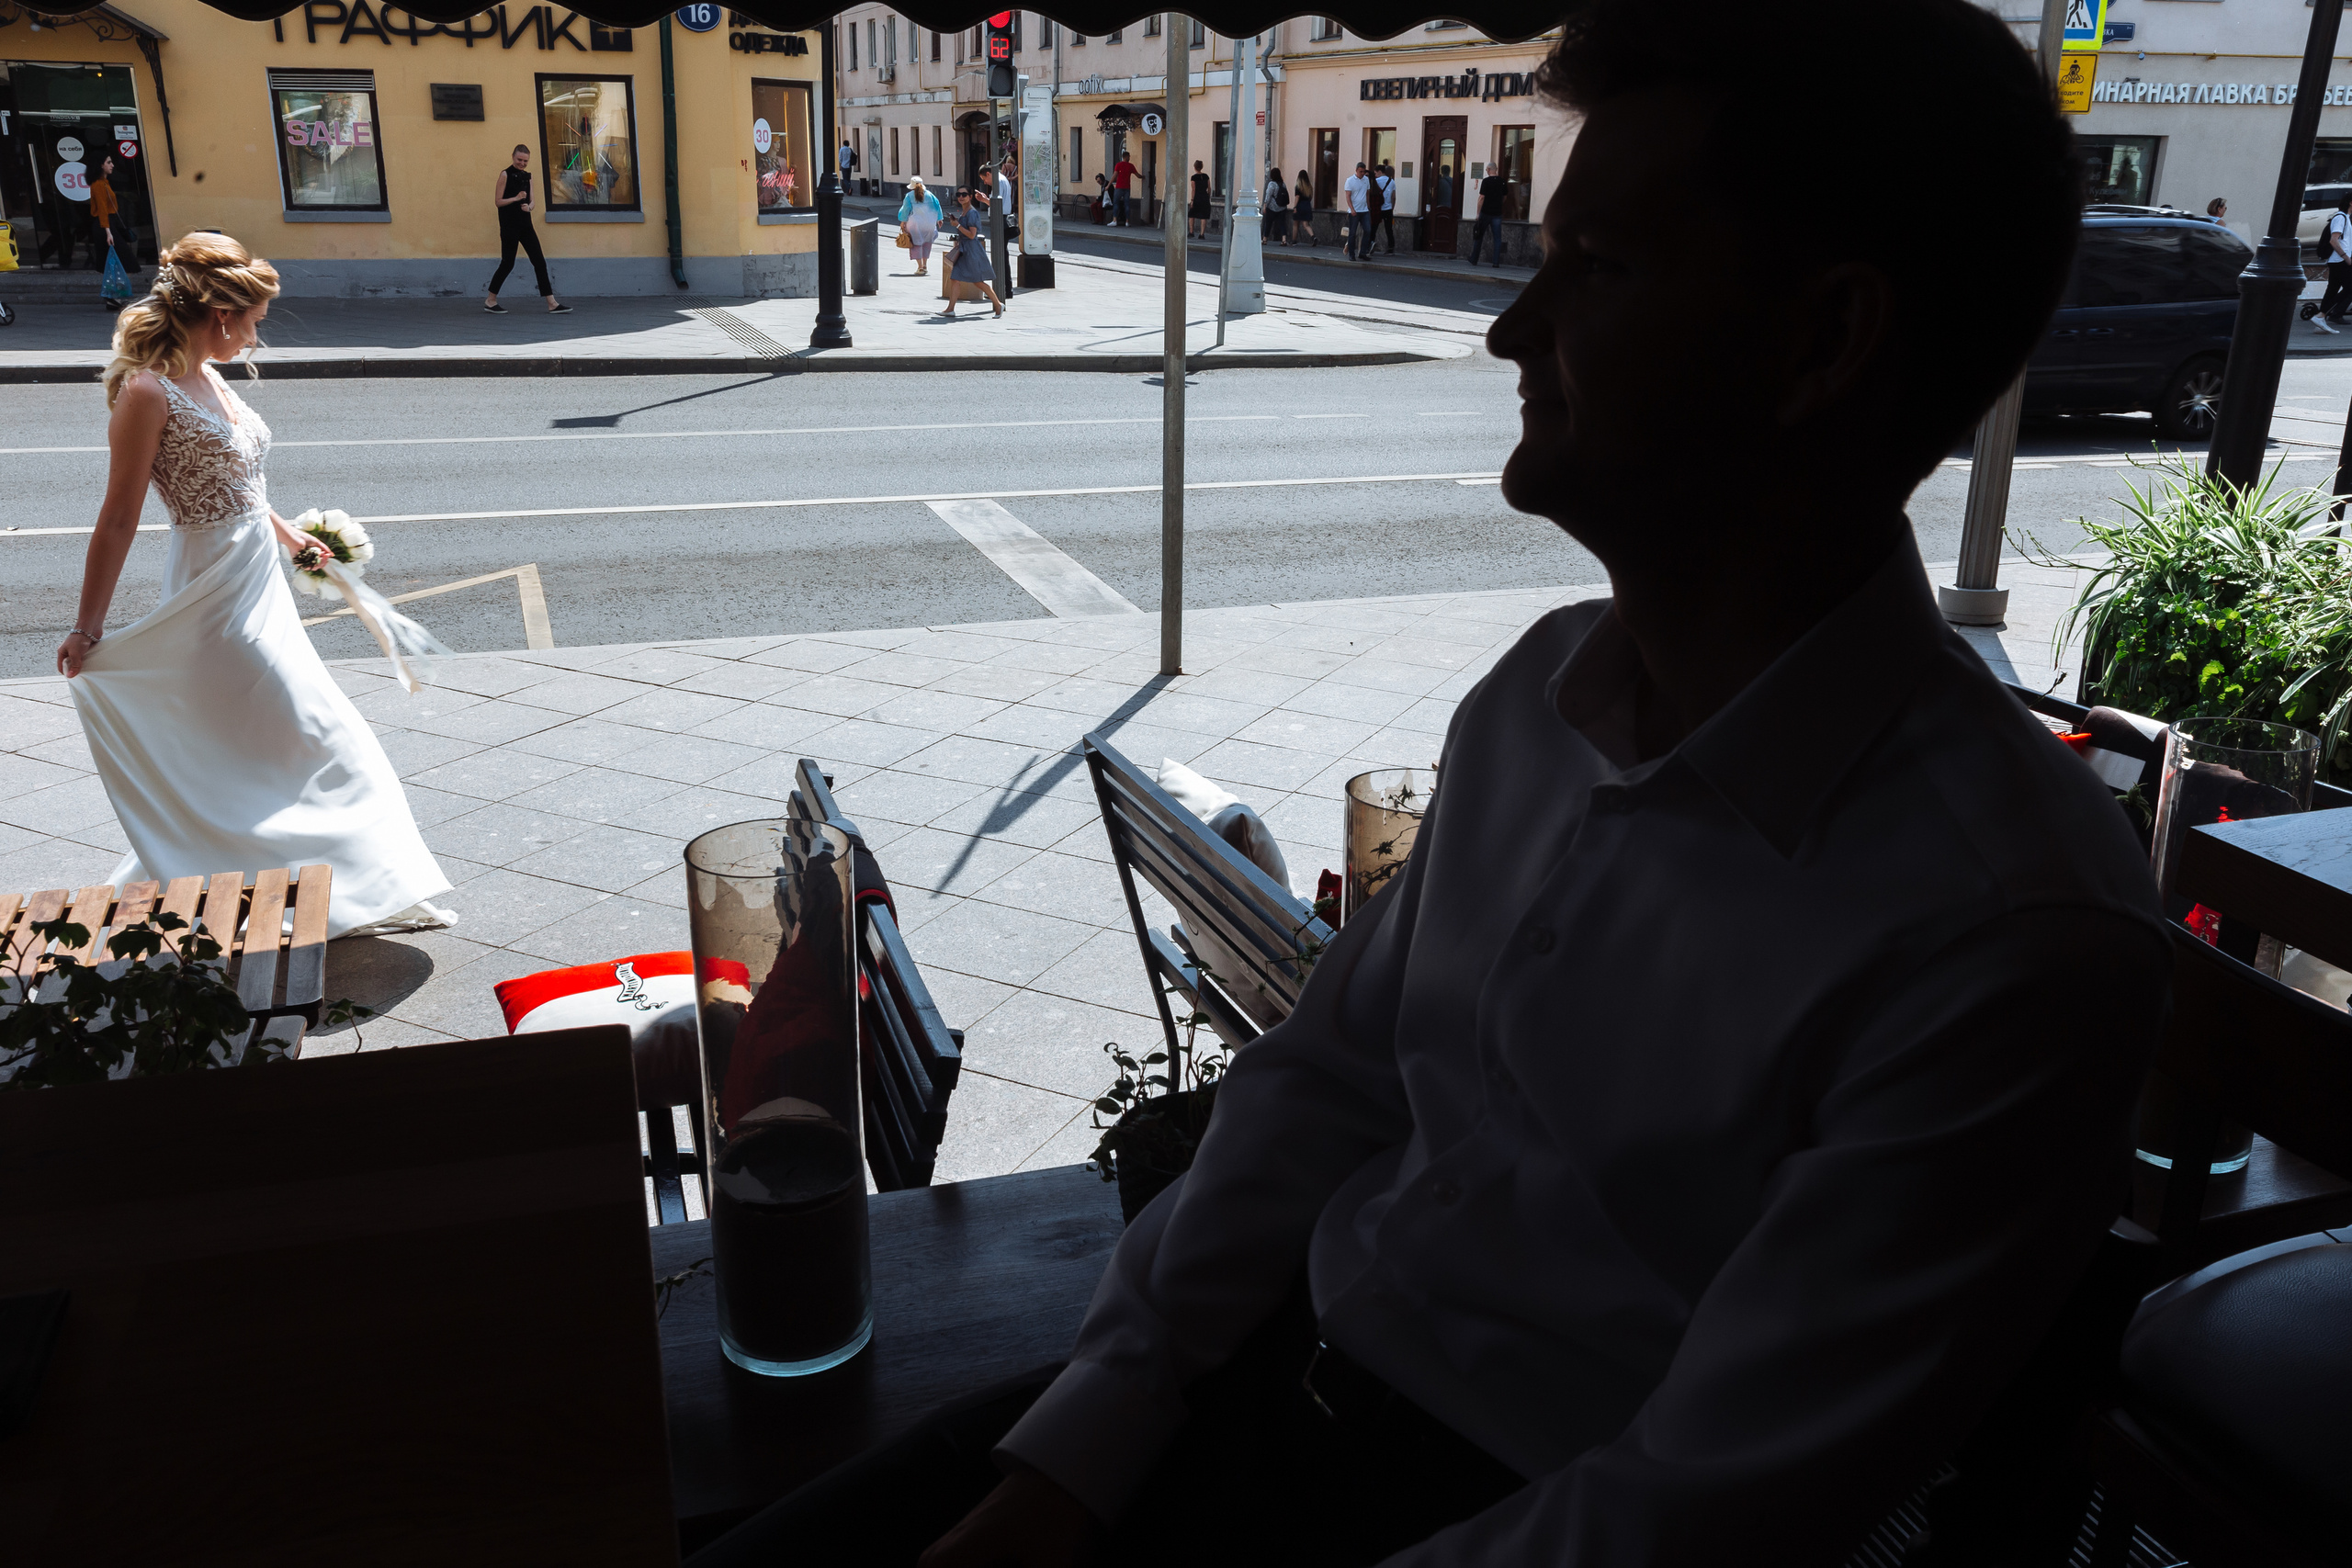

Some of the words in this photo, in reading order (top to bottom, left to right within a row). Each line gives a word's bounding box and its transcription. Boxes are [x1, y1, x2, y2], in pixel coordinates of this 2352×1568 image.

[688, 3, 711, 23] 16
[729, 32, 809, 57] ОДЕЖДА
[990, 38, 1010, 58] 62
[1078, 74, 1102, 95] cofix
[1360, 68, 1479, 101] ЮВЕЛИРНЫЙ
[1482, 72, 1535, 103] ДОМ
[2092, 81, 2190, 103] ИНАРНАЯ
[2193, 83, 2267, 105] ЛАВКА
[2272, 84, 2352, 106] БРЬЕВ
[286, 119, 373, 147] SALE
[755, 129, 769, 143] 30
